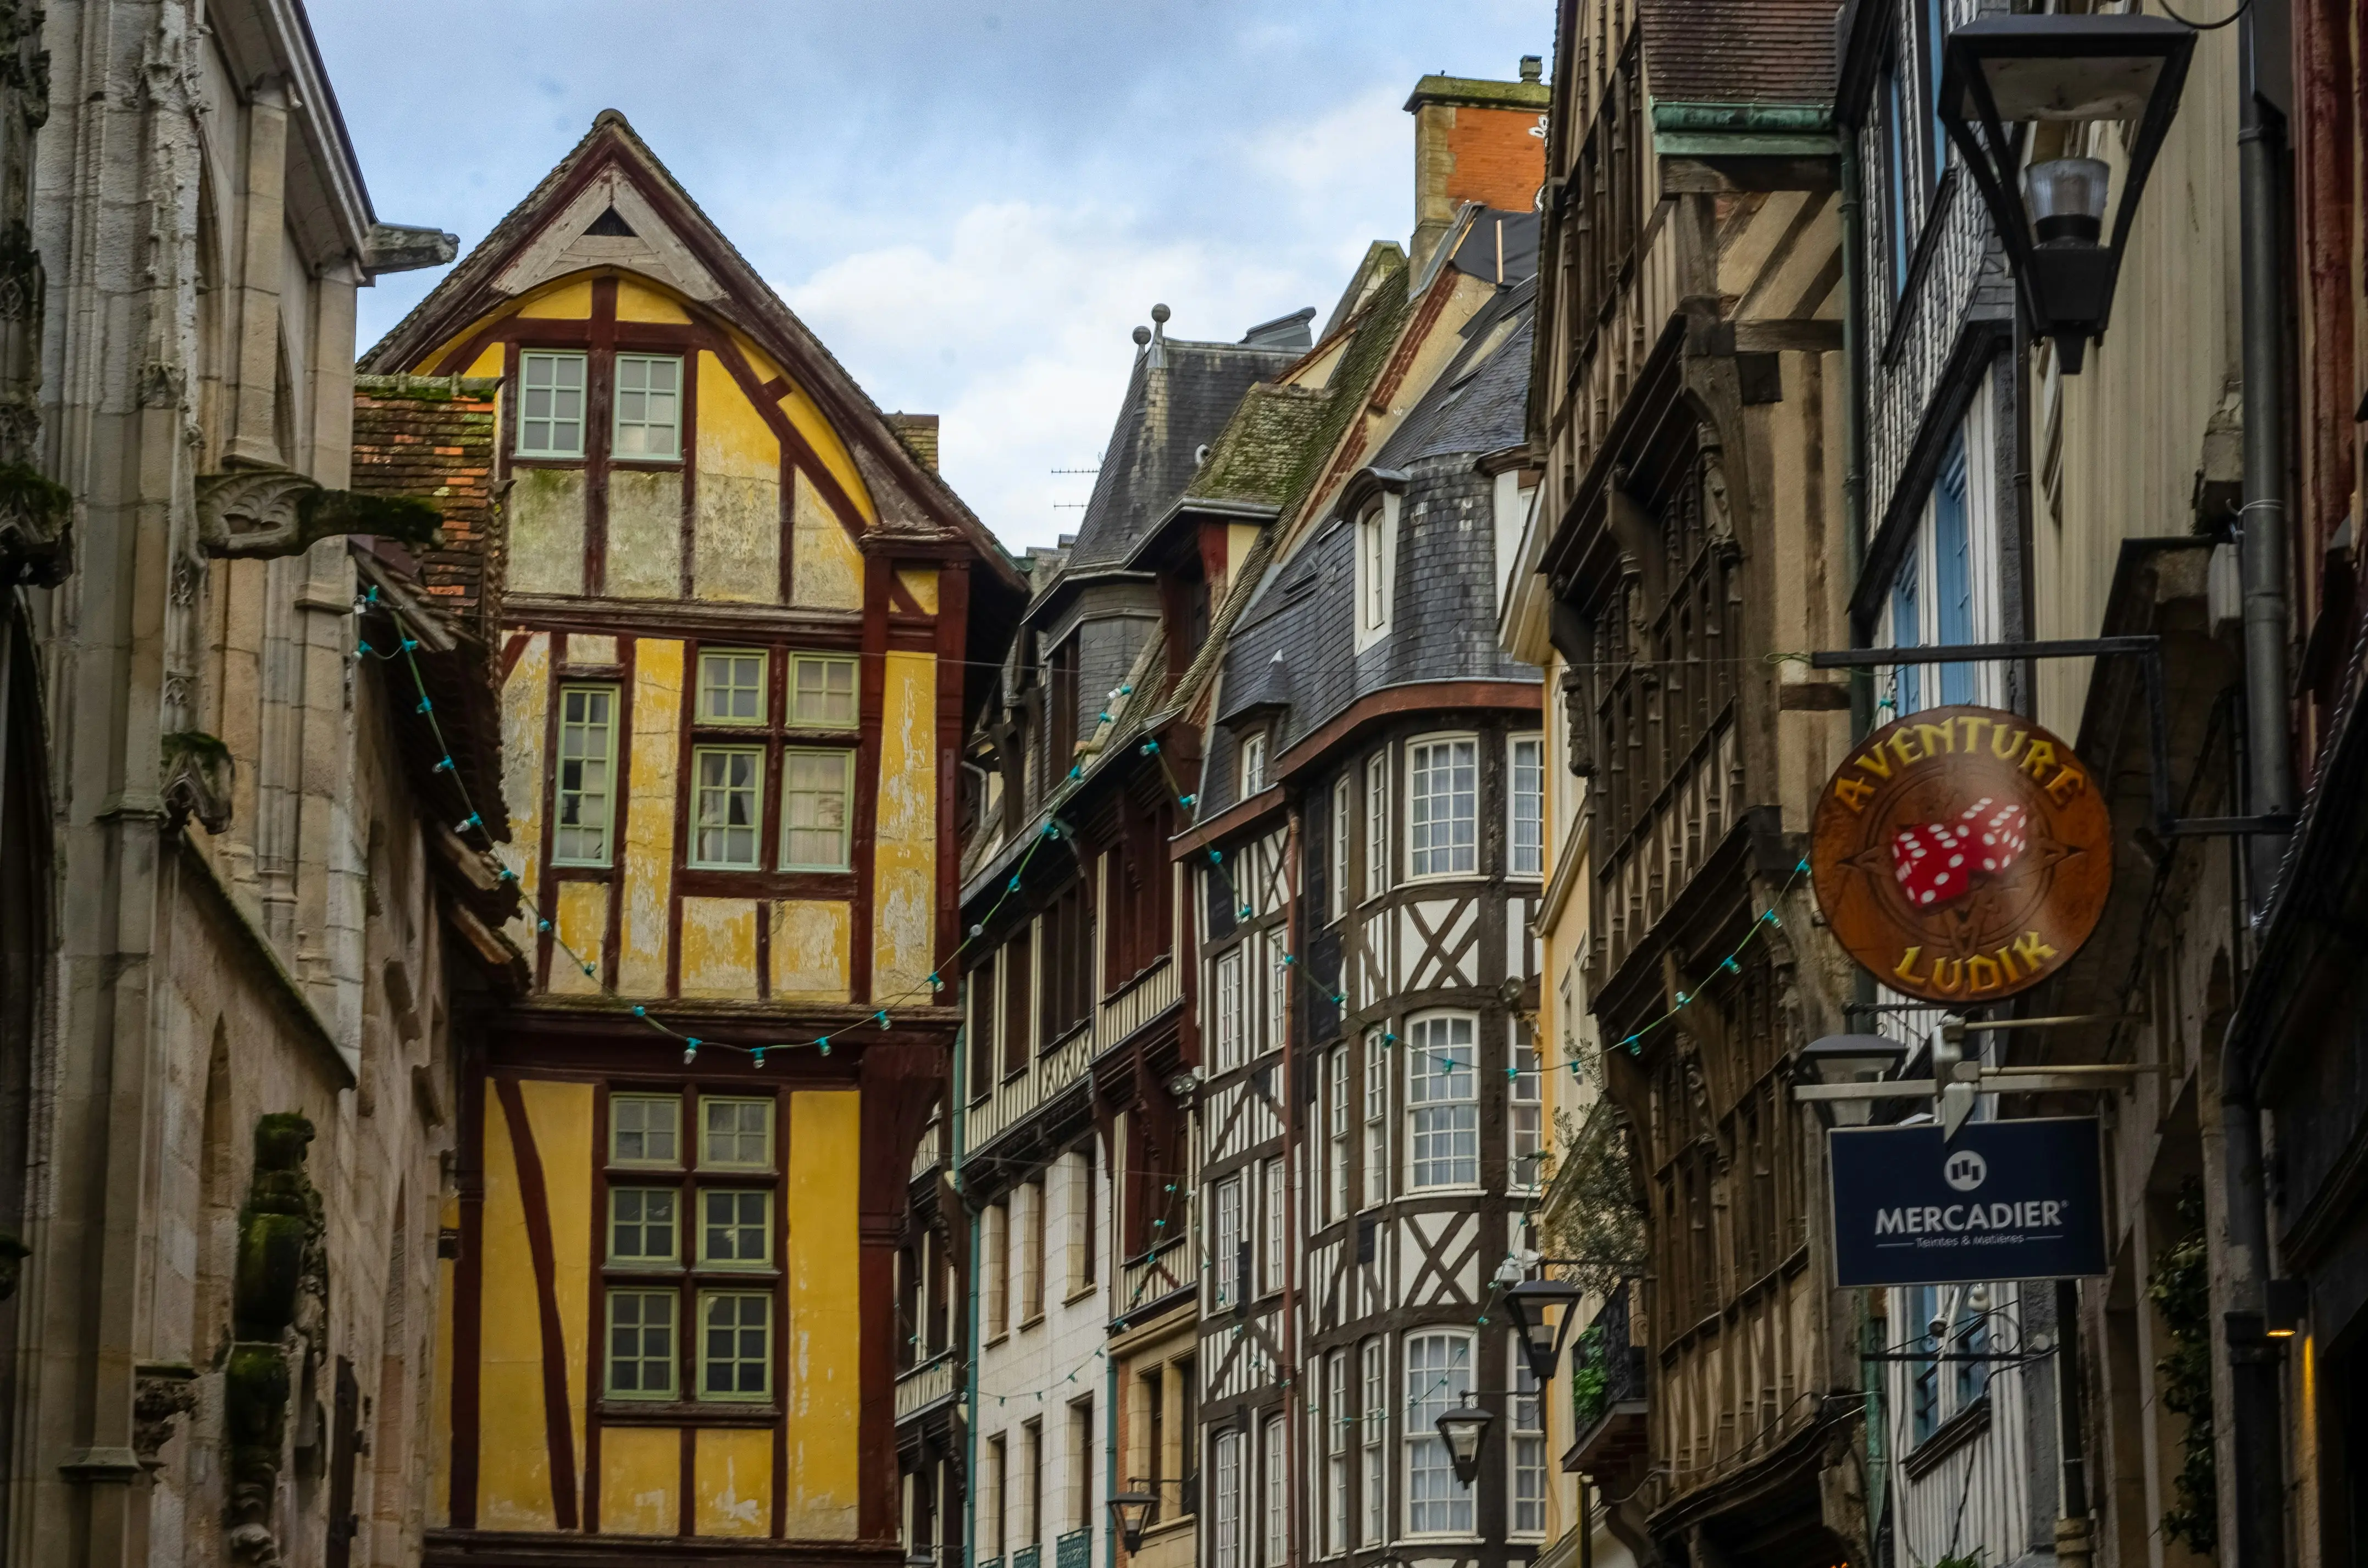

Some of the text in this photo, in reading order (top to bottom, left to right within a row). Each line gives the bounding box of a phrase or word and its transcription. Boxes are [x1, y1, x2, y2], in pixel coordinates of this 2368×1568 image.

[1834, 715, 2088, 814] AVENTURE
[1893, 931, 2059, 993] LUDIK
[1915, 1237, 1959, 1249] Teintes
[1961, 1235, 1971, 1247] &
